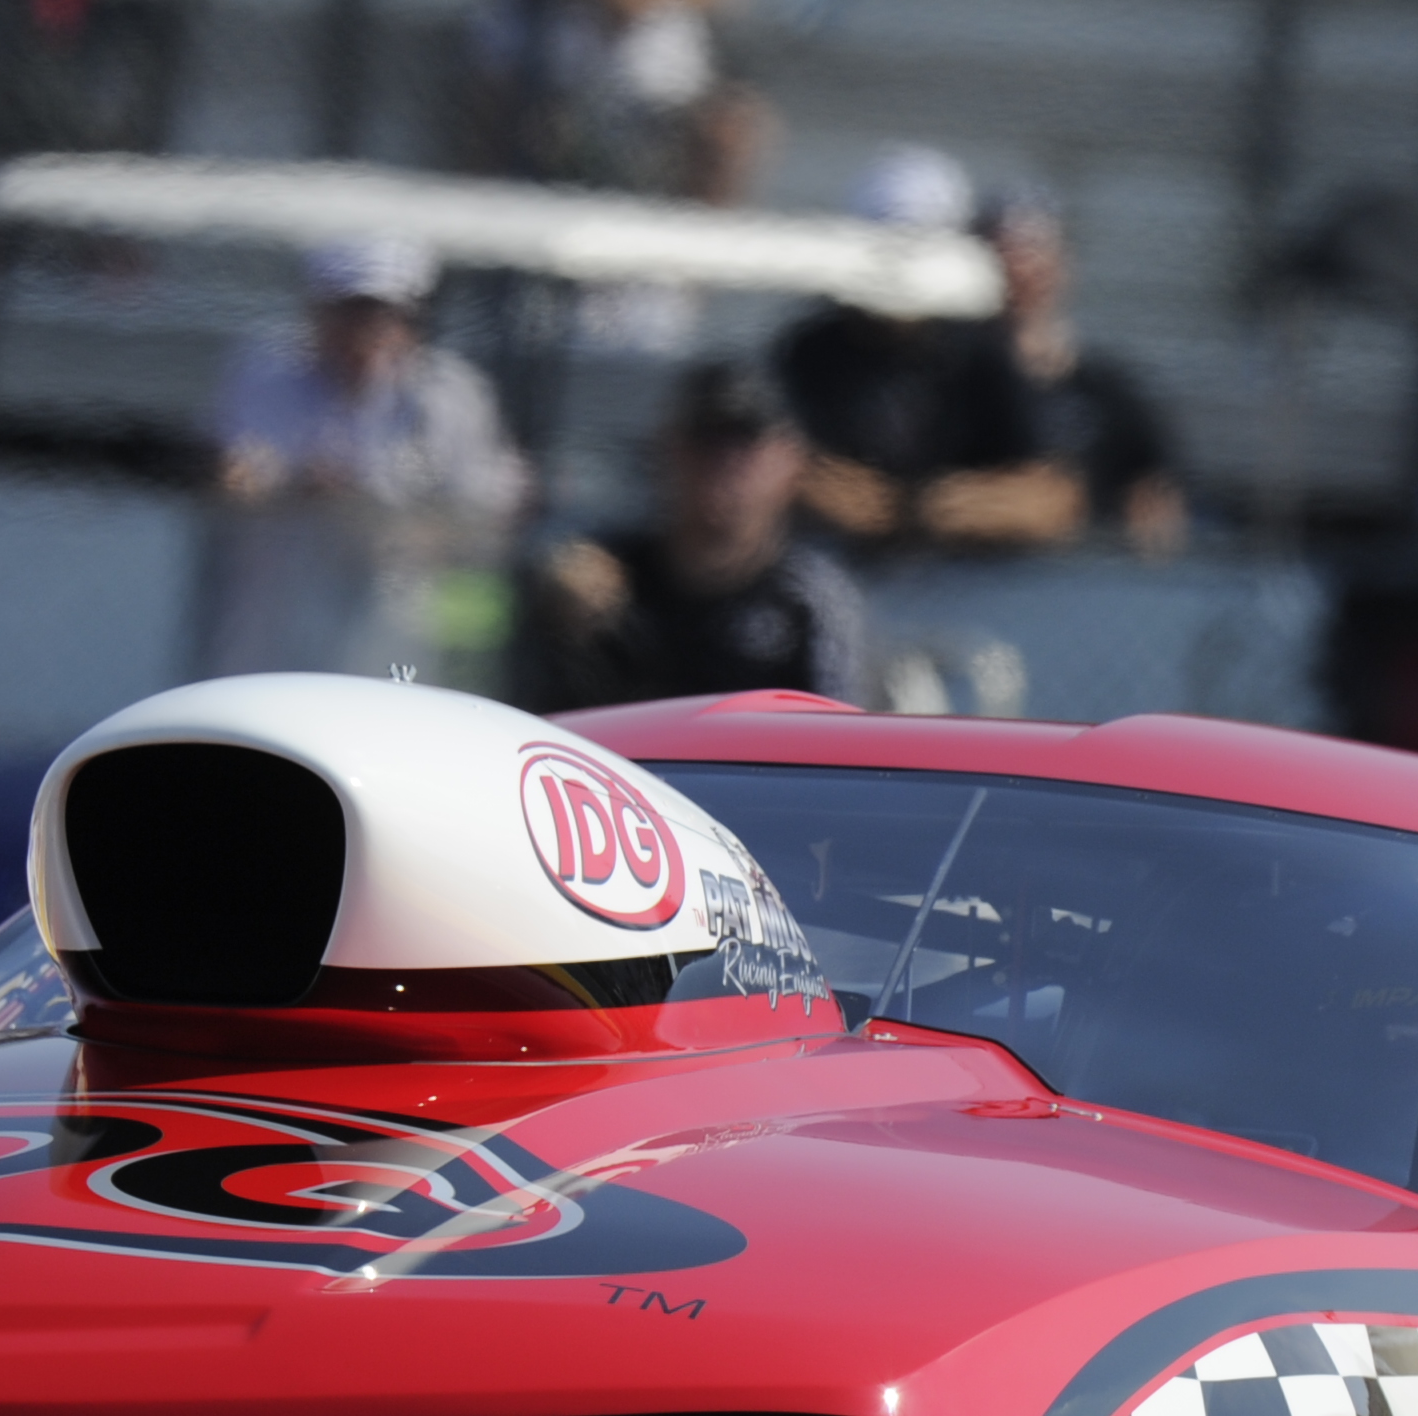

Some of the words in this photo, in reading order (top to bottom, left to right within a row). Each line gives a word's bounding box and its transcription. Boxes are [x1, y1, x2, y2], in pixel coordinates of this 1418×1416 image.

[538, 774, 661, 889] IDG
[692, 907, 706, 928] TM
[699, 868, 752, 945] PAT
[718, 938, 778, 1012] Racing
[598, 1282, 709, 1321] TM
